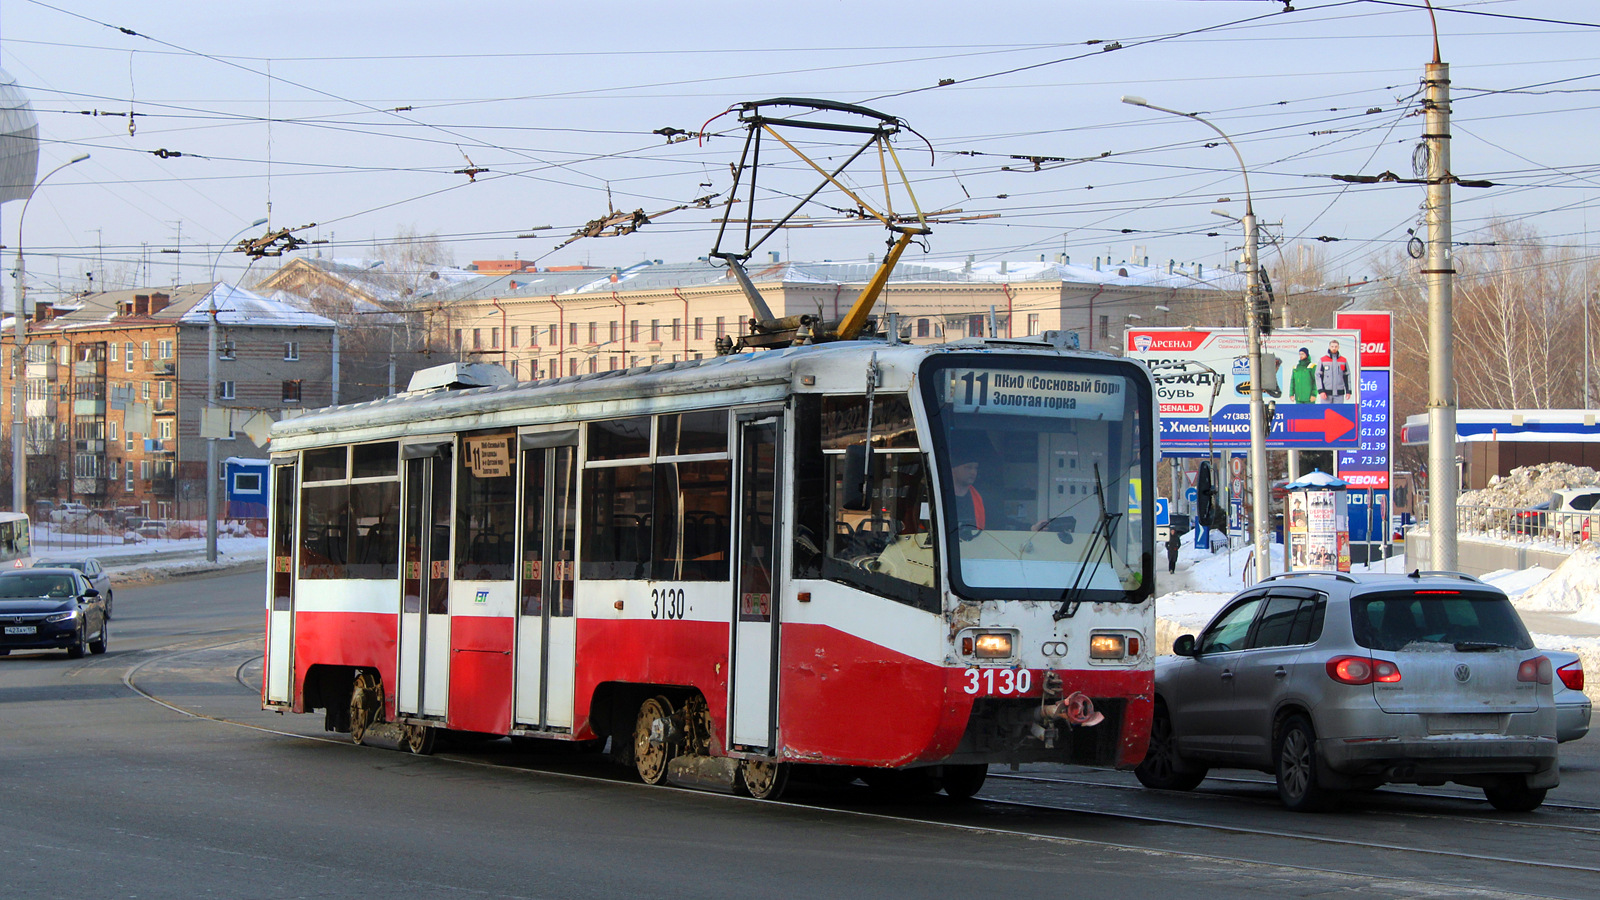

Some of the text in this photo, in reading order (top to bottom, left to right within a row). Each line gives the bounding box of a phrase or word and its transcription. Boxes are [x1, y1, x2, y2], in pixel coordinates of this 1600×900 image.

[1151, 340, 1192, 348] АРСЕНАЛ
[1360, 342, 1386, 353] BOIL
[961, 371, 989, 406] 11
[994, 374, 1120, 394] ПКиО «Сосновый бор»
[1361, 380, 1378, 391] afé
[1157, 387, 1195, 399] бувь
[993, 391, 1077, 409] Золотая горка
[1361, 400, 1386, 408] 54.74
[1361, 414, 1386, 422] 58.59
[1361, 428, 1386, 436] 61.09
[1361, 442, 1386, 450] 81.39
[1361, 457, 1386, 465] 73.39
[1343, 475, 1386, 485] TEBOIL+
[651, 588, 685, 620] 3130
[963, 668, 1031, 695] 3130
